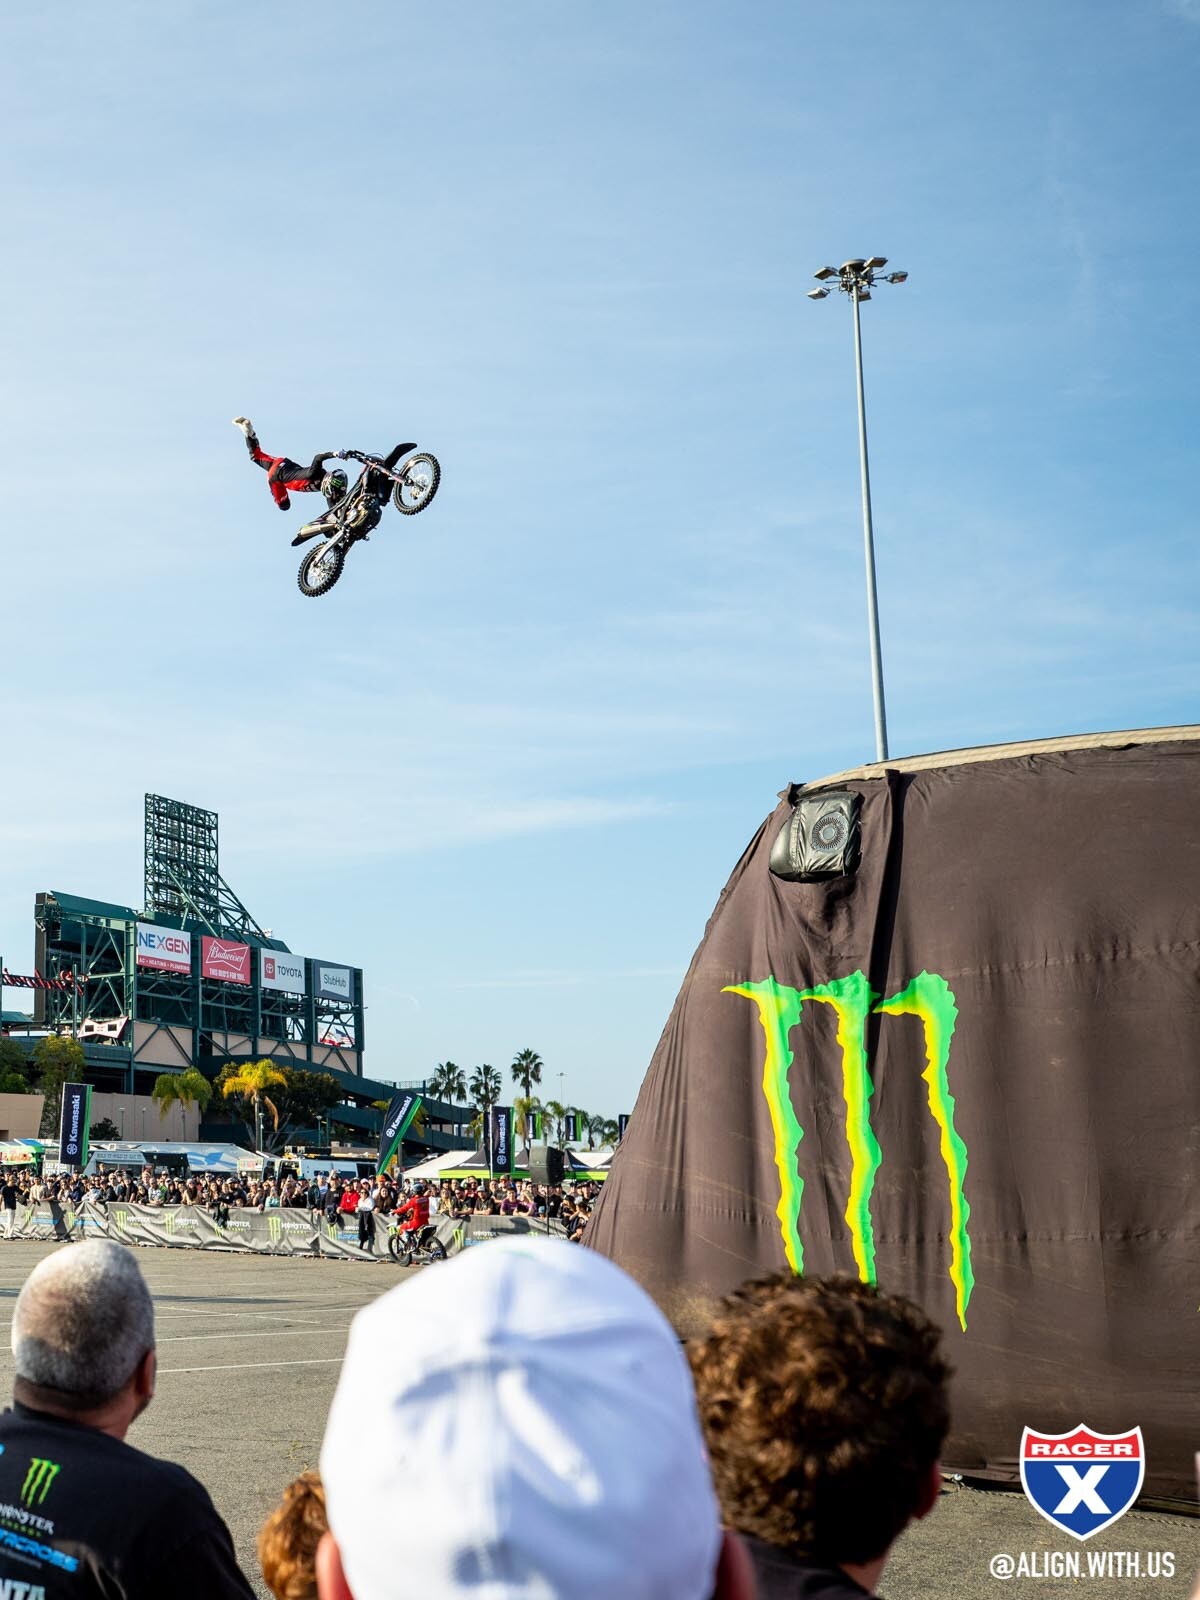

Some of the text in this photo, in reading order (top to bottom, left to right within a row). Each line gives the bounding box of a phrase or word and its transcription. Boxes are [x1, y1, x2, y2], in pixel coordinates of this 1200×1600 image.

[139, 931, 190, 954] NEXGEN
[210, 945, 245, 963] Budweiser
[277, 965, 302, 978] TOYOTA
[324, 974, 347, 988] StubHub
[69, 1095, 81, 1142] Kawasaki
[391, 1096, 412, 1129] Kawasaki
[498, 1114, 506, 1154] Kawasaki
[281, 1221, 312, 1231] MONSTER
